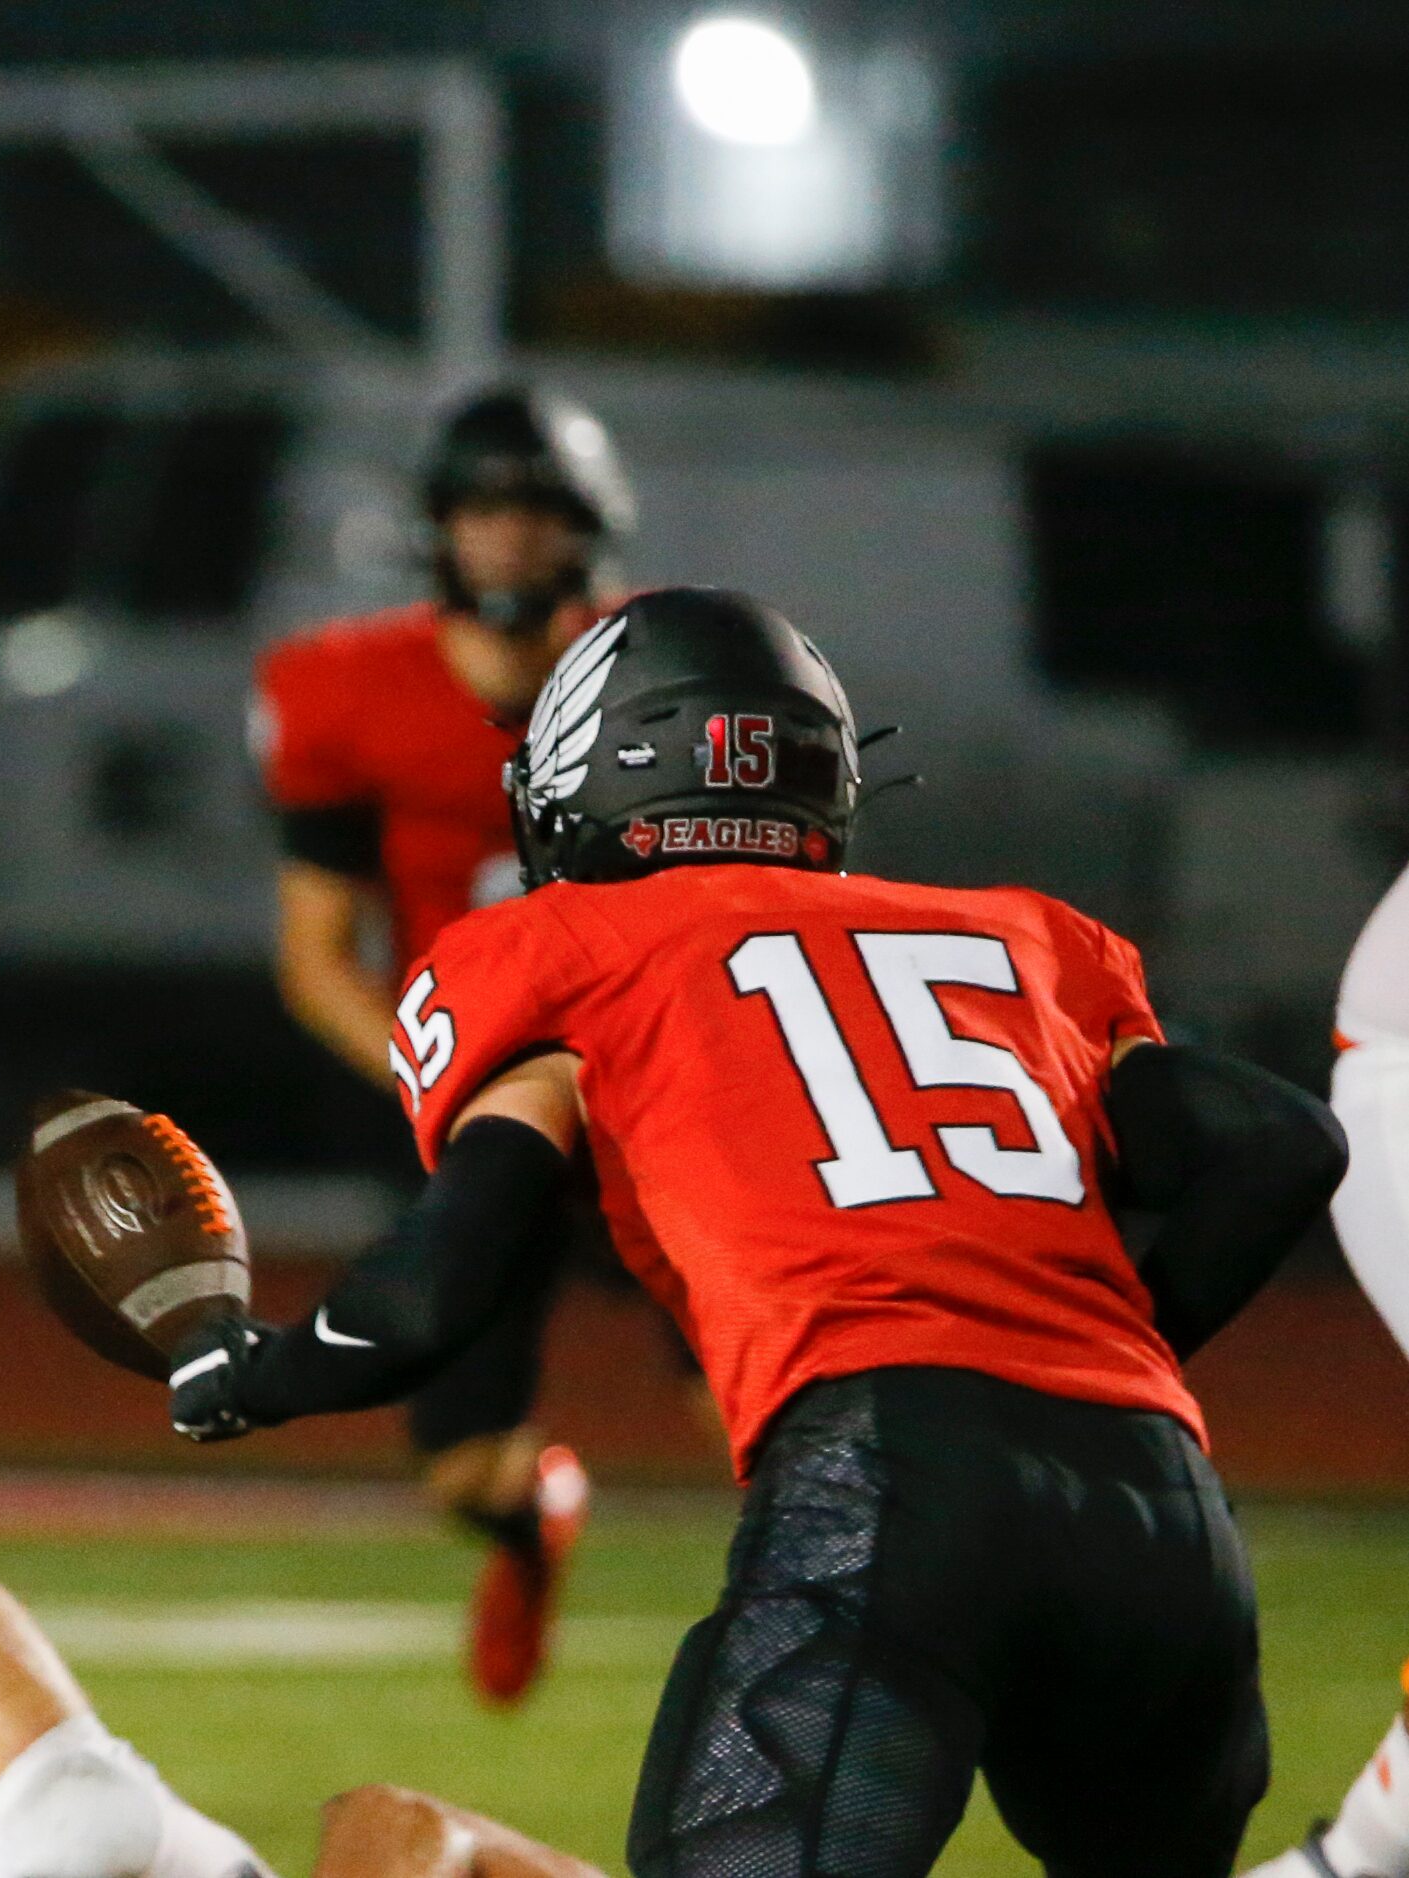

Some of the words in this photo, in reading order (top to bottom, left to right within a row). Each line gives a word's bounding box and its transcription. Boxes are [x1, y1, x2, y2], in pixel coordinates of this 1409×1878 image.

[705, 714, 775, 788] 15
[661, 818, 799, 858] EAGLES
[724, 931, 1087, 1210] 15
